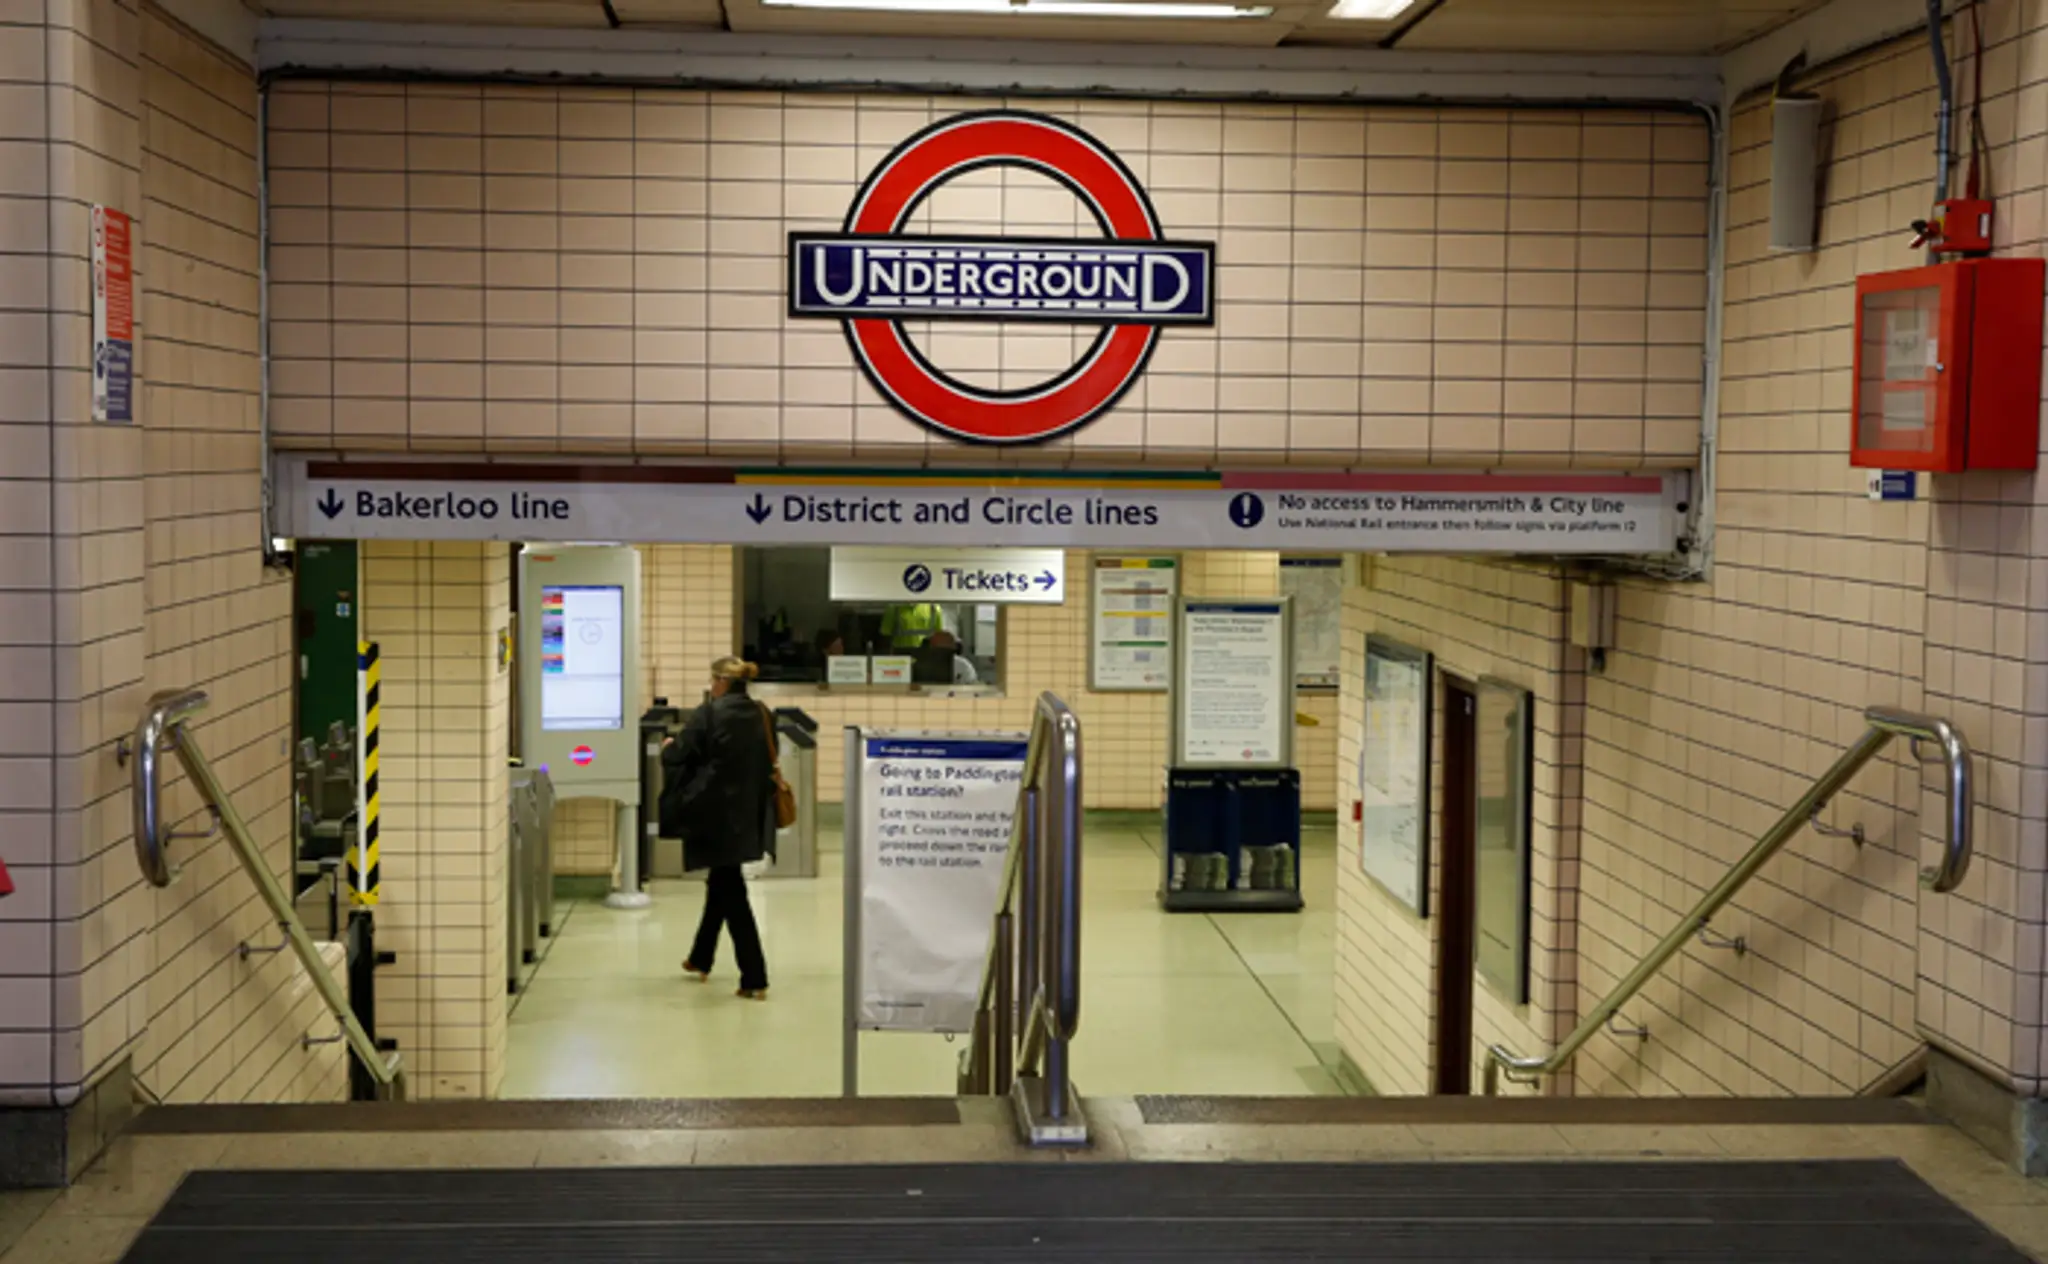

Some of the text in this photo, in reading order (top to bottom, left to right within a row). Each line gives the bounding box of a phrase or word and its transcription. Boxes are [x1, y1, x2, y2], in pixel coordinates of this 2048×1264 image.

[814, 247, 1190, 312] UNDERGROUND
[356, 491, 569, 520] Bakerloo line
[783, 496, 1158, 526] District and Circle lines
[1278, 494, 1626, 516] No access to Hammersmith & City line
[1278, 517, 1637, 534] Use National Rail entrance then follow signs via platform 12
[943, 568, 1029, 591] Tickets
[880, 764, 921, 780] Going
[925, 765, 941, 779] to
[880, 784, 964, 798] rail station?
[880, 807, 901, 820] Exit
[904, 809, 926, 820] this
[930, 809, 972, 821] station
[974, 810, 996, 822] and
[912, 824, 947, 836] Cross
[950, 825, 969, 836] the
[972, 826, 998, 838] road
[931, 841, 963, 853] down
[966, 842, 986, 853] the
[879, 857, 892, 868] to
[895, 856, 916, 868] the
[918, 856, 937, 867] rail
